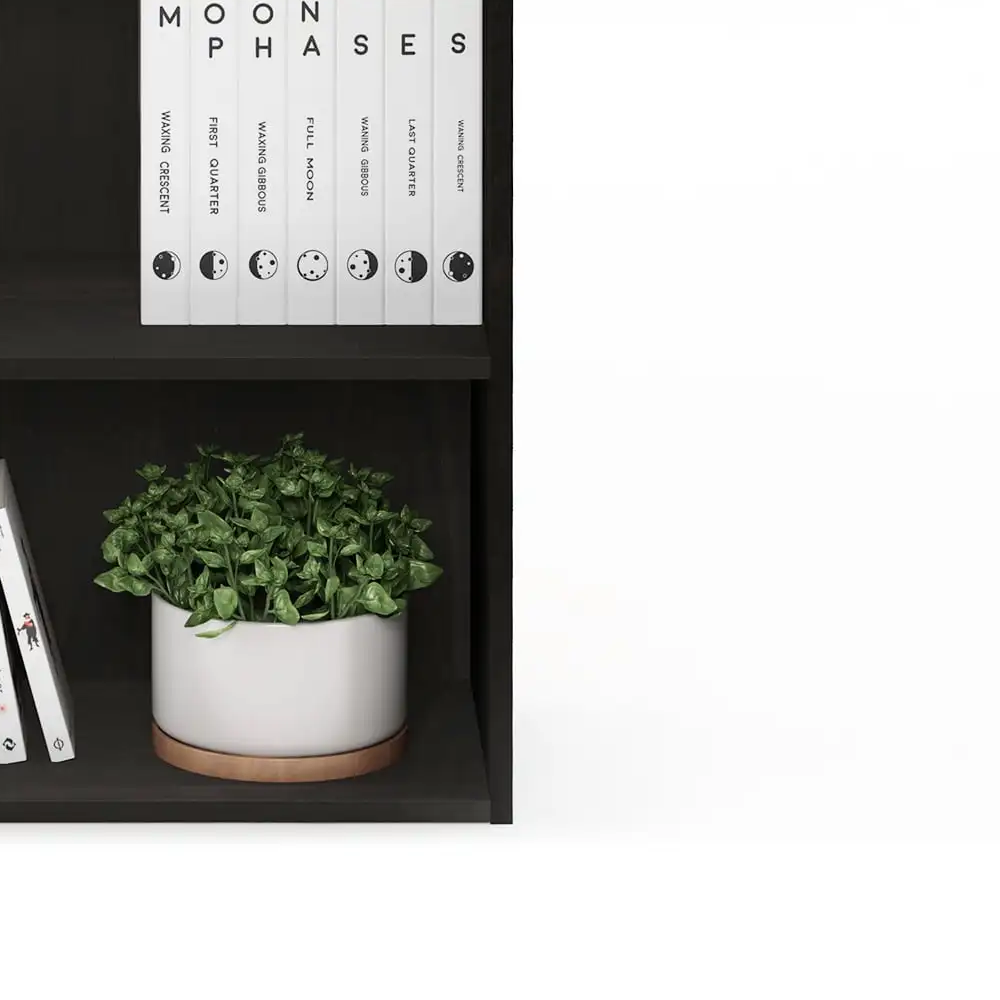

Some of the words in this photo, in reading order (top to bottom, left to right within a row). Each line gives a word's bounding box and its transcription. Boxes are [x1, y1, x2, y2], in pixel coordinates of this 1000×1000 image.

[160, 110, 172, 154] WAXING
[208, 116, 218, 148] FIRST
[258, 120, 267, 165] WAXING
[306, 116, 315, 150] FULL
[360, 116, 370, 153] WANING
[408, 118, 416, 145] LAST
[457, 119, 465, 152] WANING
[158, 160, 171, 215] CRESCENT
[208, 158, 220, 216] QUARTER
[256, 166, 267, 214] GIBBOUS
[305, 156, 315, 202] MOON
[360, 157, 370, 198] GIBBOUS
[407, 146, 416, 198] QUARTER
[456, 154, 465, 193] CRESCENT
